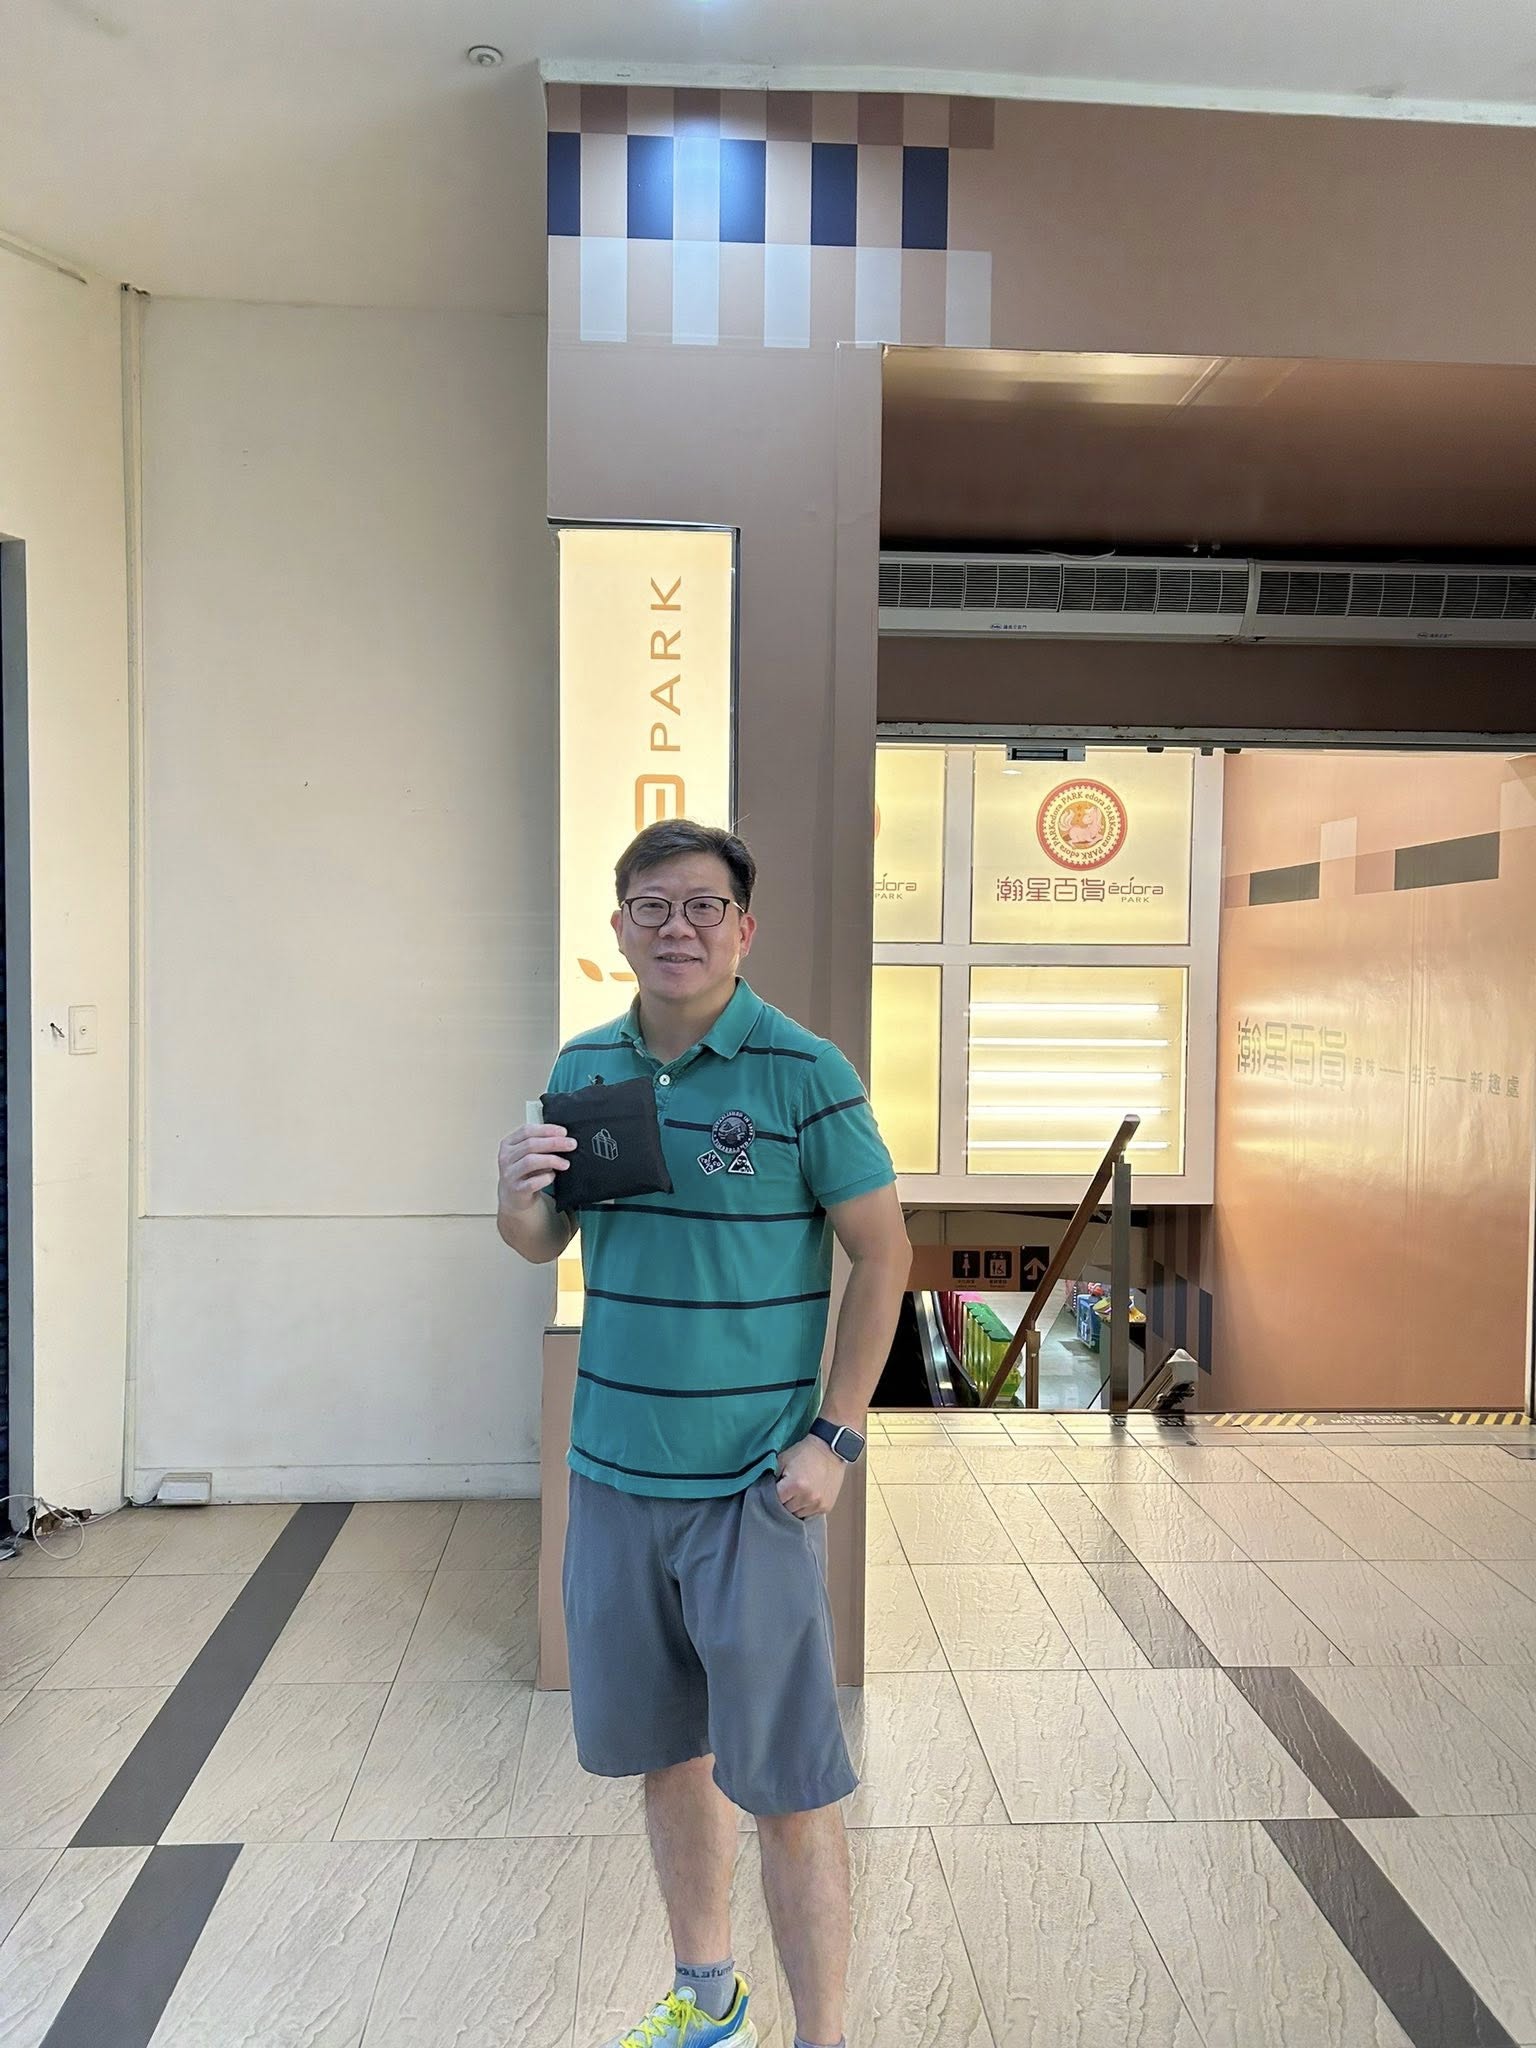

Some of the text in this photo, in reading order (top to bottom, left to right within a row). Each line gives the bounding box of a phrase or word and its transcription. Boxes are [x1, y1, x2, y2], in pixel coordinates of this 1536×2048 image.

[650, 575, 682, 752] PARK
[1061, 791, 1084, 804] PARK
[1084, 793, 1116, 828] edora PARK
[1048, 824, 1058, 847] PARK
[1081, 847, 1104, 860] PARK
[997, 876, 1105, 902] 瀚星百貨
